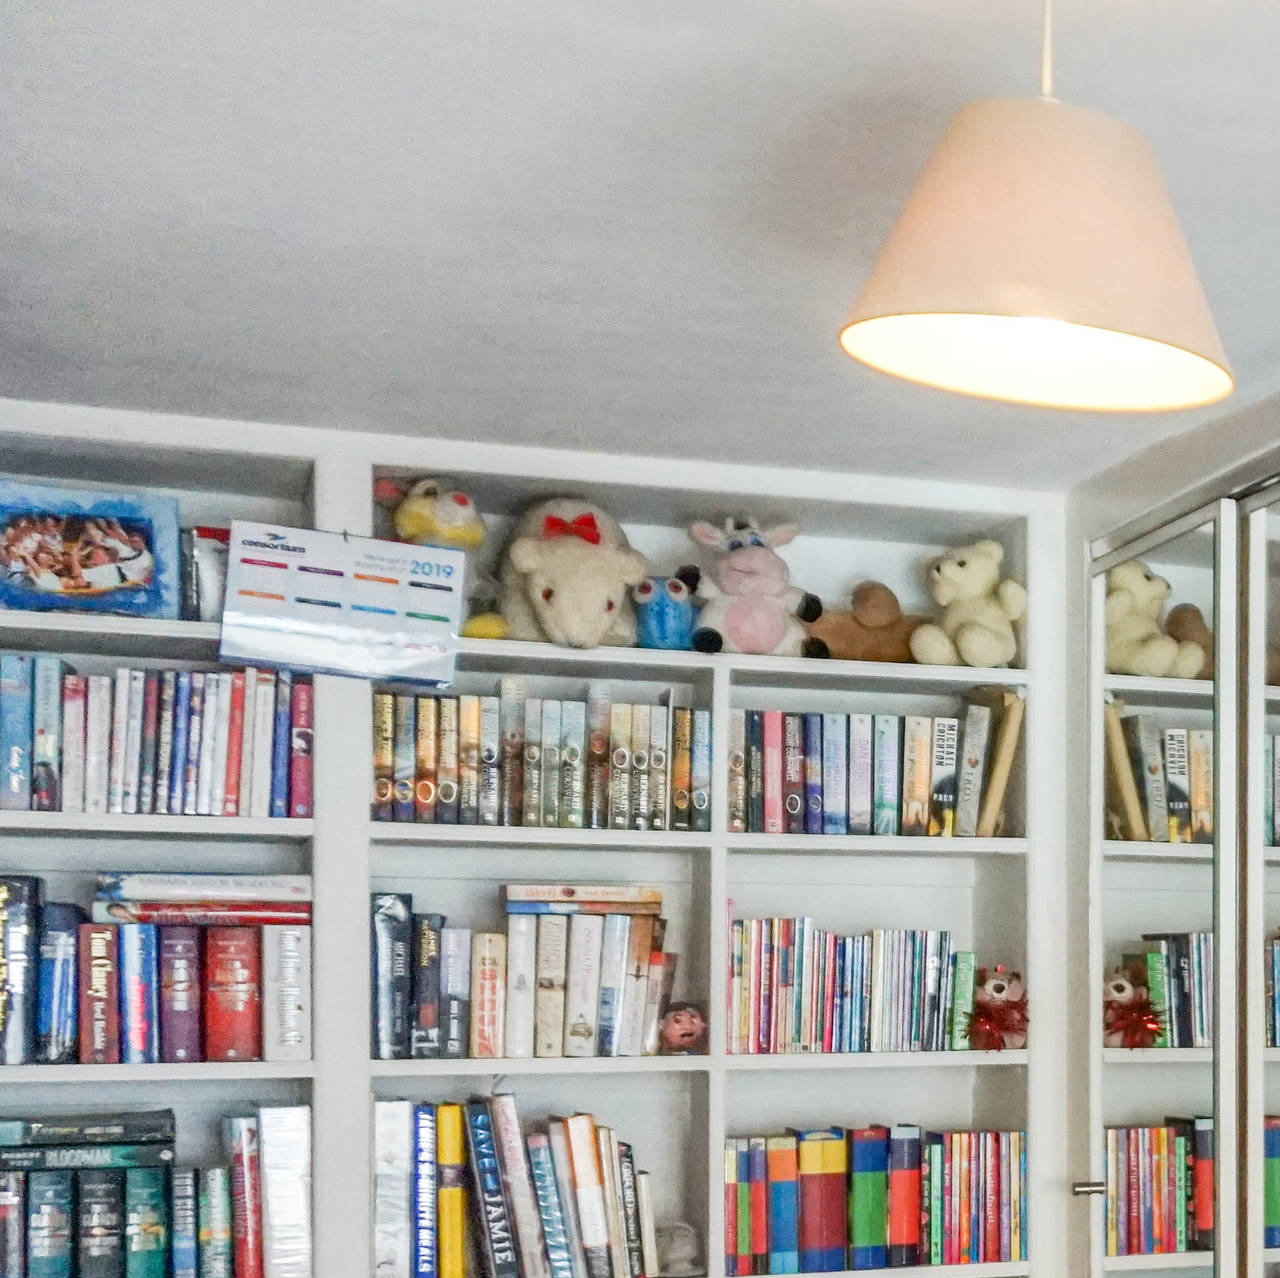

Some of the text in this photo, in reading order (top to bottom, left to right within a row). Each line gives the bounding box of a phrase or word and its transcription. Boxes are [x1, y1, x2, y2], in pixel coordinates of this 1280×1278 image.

[241, 538, 306, 554] consortium
[409, 559, 455, 579] 2019
[859, 739, 868, 761] DAN
[936, 723, 945, 766] CRICHTON
[945, 724, 956, 767] MICHAEL
[489, 768, 497, 806] BERNARD
[572, 770, 580, 809] BERNARD
[620, 773, 628, 811] BERNARD
[933, 793, 953, 802] PREY
[6, 924, 27, 995] Tom Clancy
[91, 931, 113, 957] Tom
[280, 931, 302, 951] Tom
[394, 941, 404, 976] MICHAEL
[421, 919, 429, 967] PATTERSON
[428, 930, 436, 956] JAMES
[87, 959, 113, 998] Clancy
[418, 1112, 433, 1161] JAMIE'S
[473, 1113, 494, 1168] SAVE
[485, 1192, 514, 1265] JAMIE
[418, 1229, 433, 1272] MEALS
